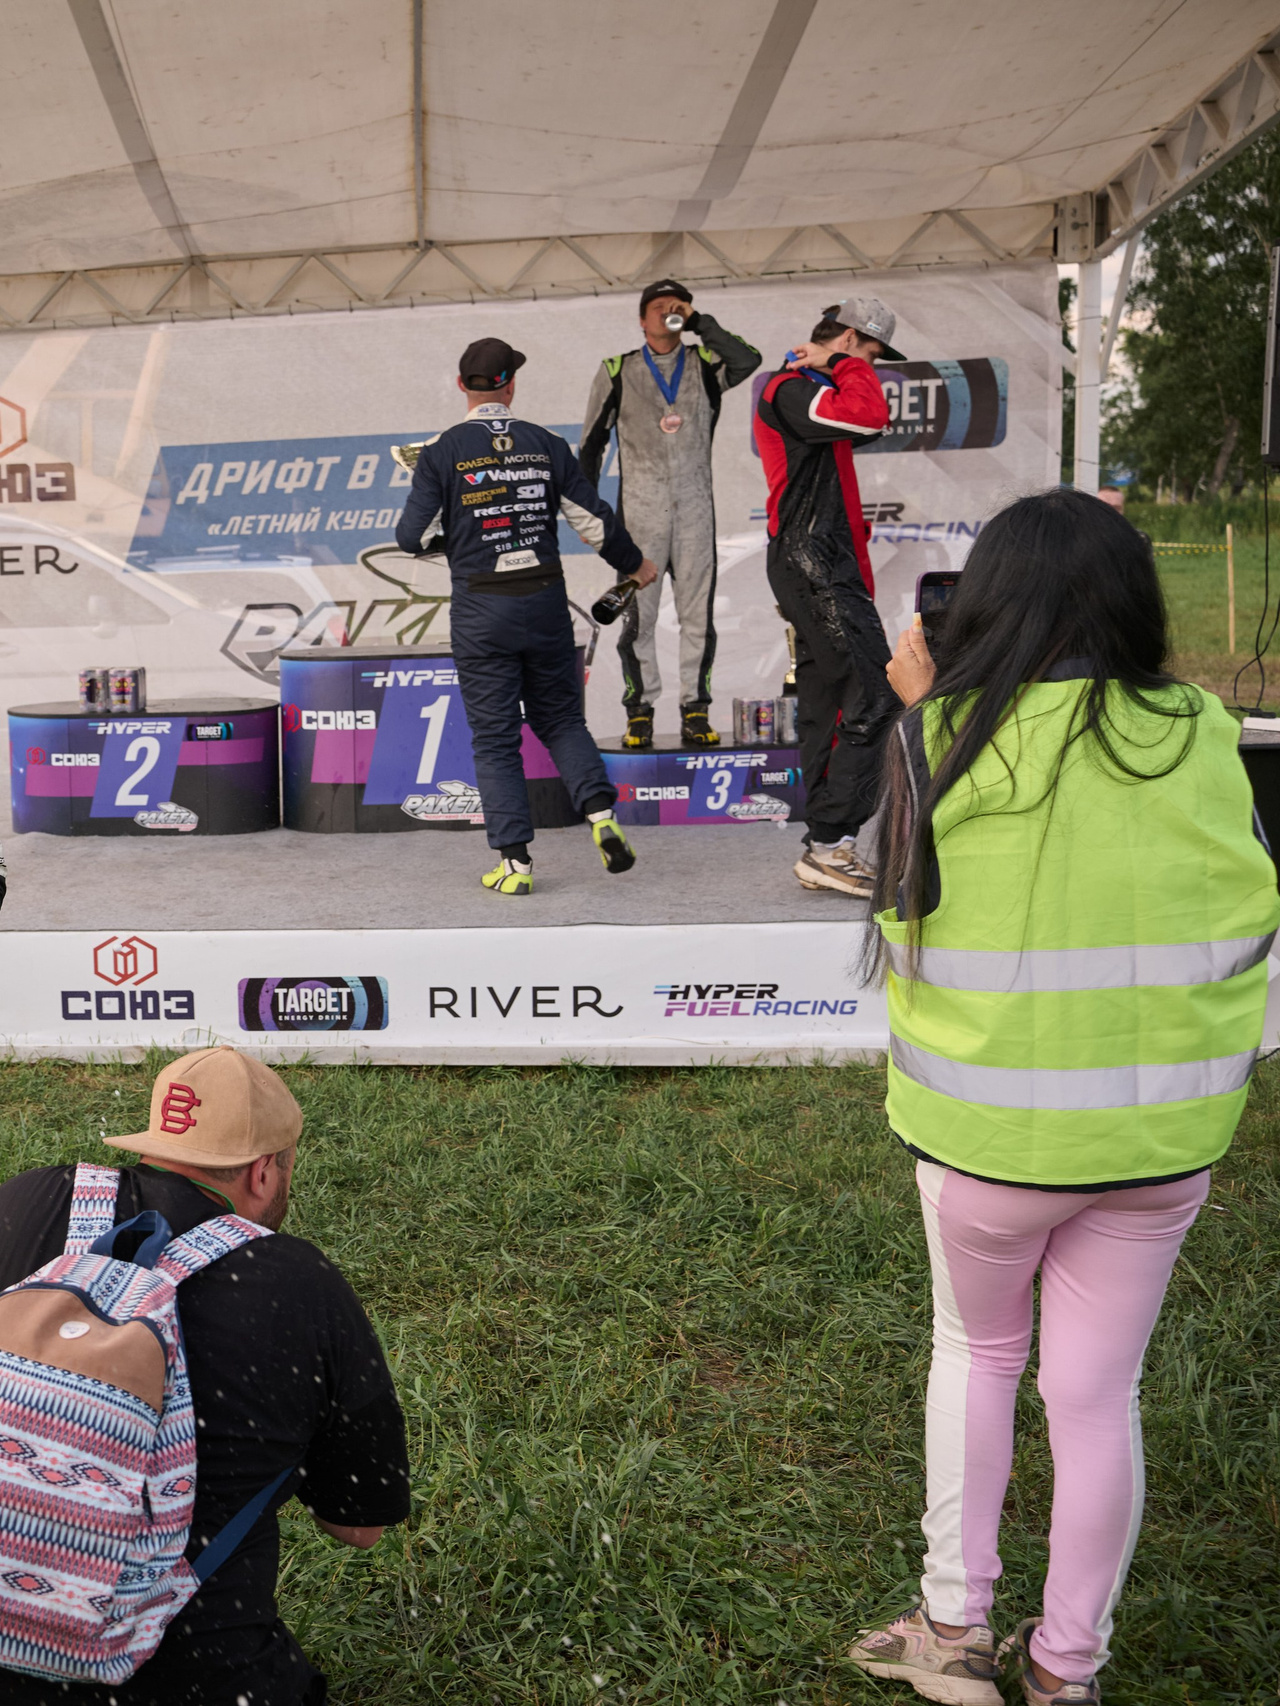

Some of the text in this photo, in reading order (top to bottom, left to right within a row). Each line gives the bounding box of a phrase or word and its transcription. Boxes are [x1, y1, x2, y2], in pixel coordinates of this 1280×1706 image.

[456, 456, 500, 471] OMEGA
[175, 456, 341, 505] ДРИФТ
[347, 454, 380, 490] В
[486, 467, 551, 481] Valvoline
[207, 507, 322, 535] «ЛЕТНИЙ
[373, 669, 458, 687] HYPE
[96, 722, 172, 734] HYPER
[301, 710, 376, 730] СОЮЗ
[196, 726, 222, 736] TARGET
[416, 695, 450, 784] 1
[51, 753, 100, 767] СОЮЗ
[686, 754, 768, 769] HYPER
[115, 736, 160, 806] 2
[760, 772, 789, 782] TARGET
[636, 786, 689, 801] СОЮЗ
[706, 770, 732, 810] 3
[274, 988, 352, 1012] TARGET
[669, 984, 779, 999] HYPER
[61, 990, 195, 1020] СОЮЗ
[429, 986, 624, 1018] RIVER
